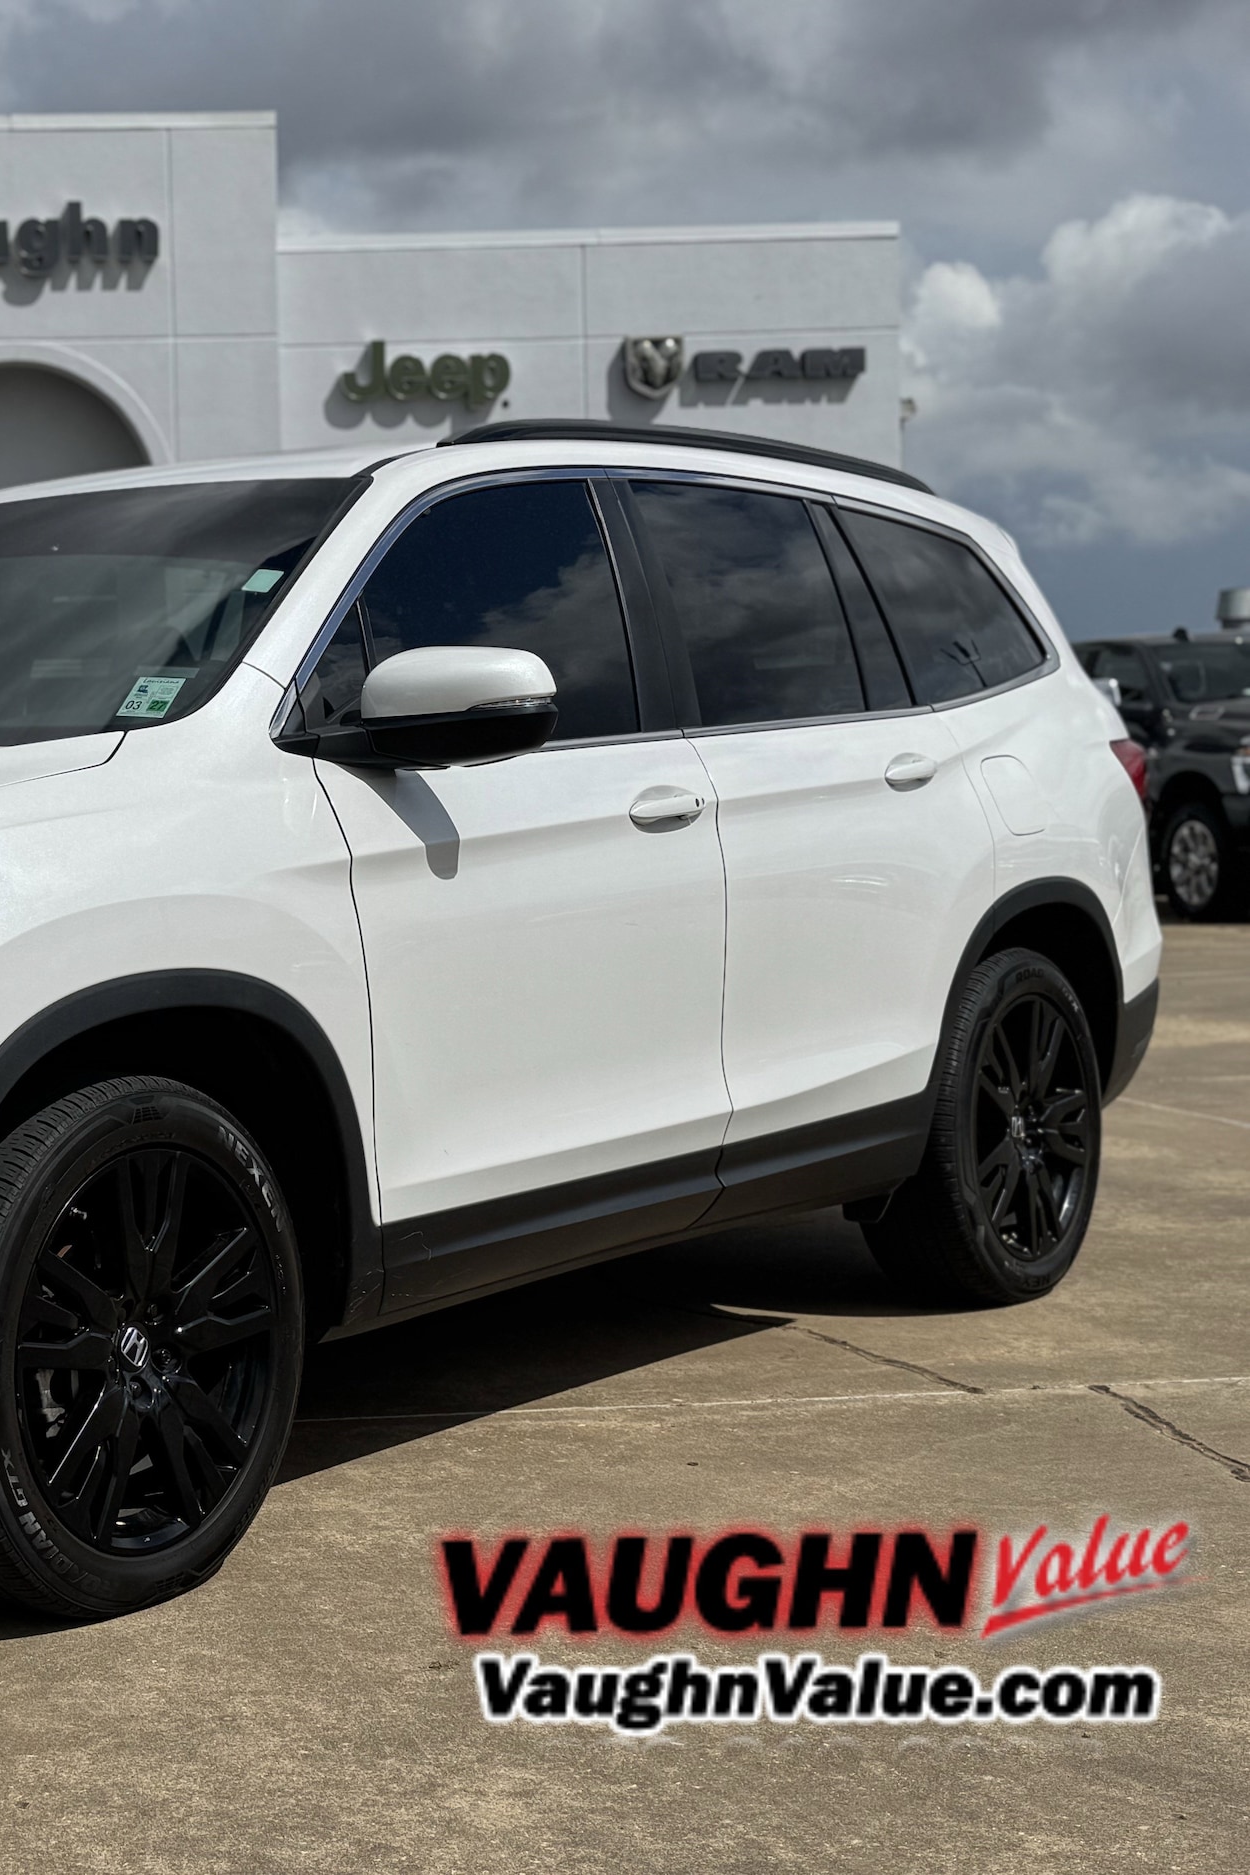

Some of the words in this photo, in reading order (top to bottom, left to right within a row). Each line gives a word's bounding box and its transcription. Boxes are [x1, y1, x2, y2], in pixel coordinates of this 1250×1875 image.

[694, 347, 866, 381] RAM
[342, 341, 510, 412] Jeep
[125, 700, 143, 710] 03
[149, 700, 166, 710] 27
